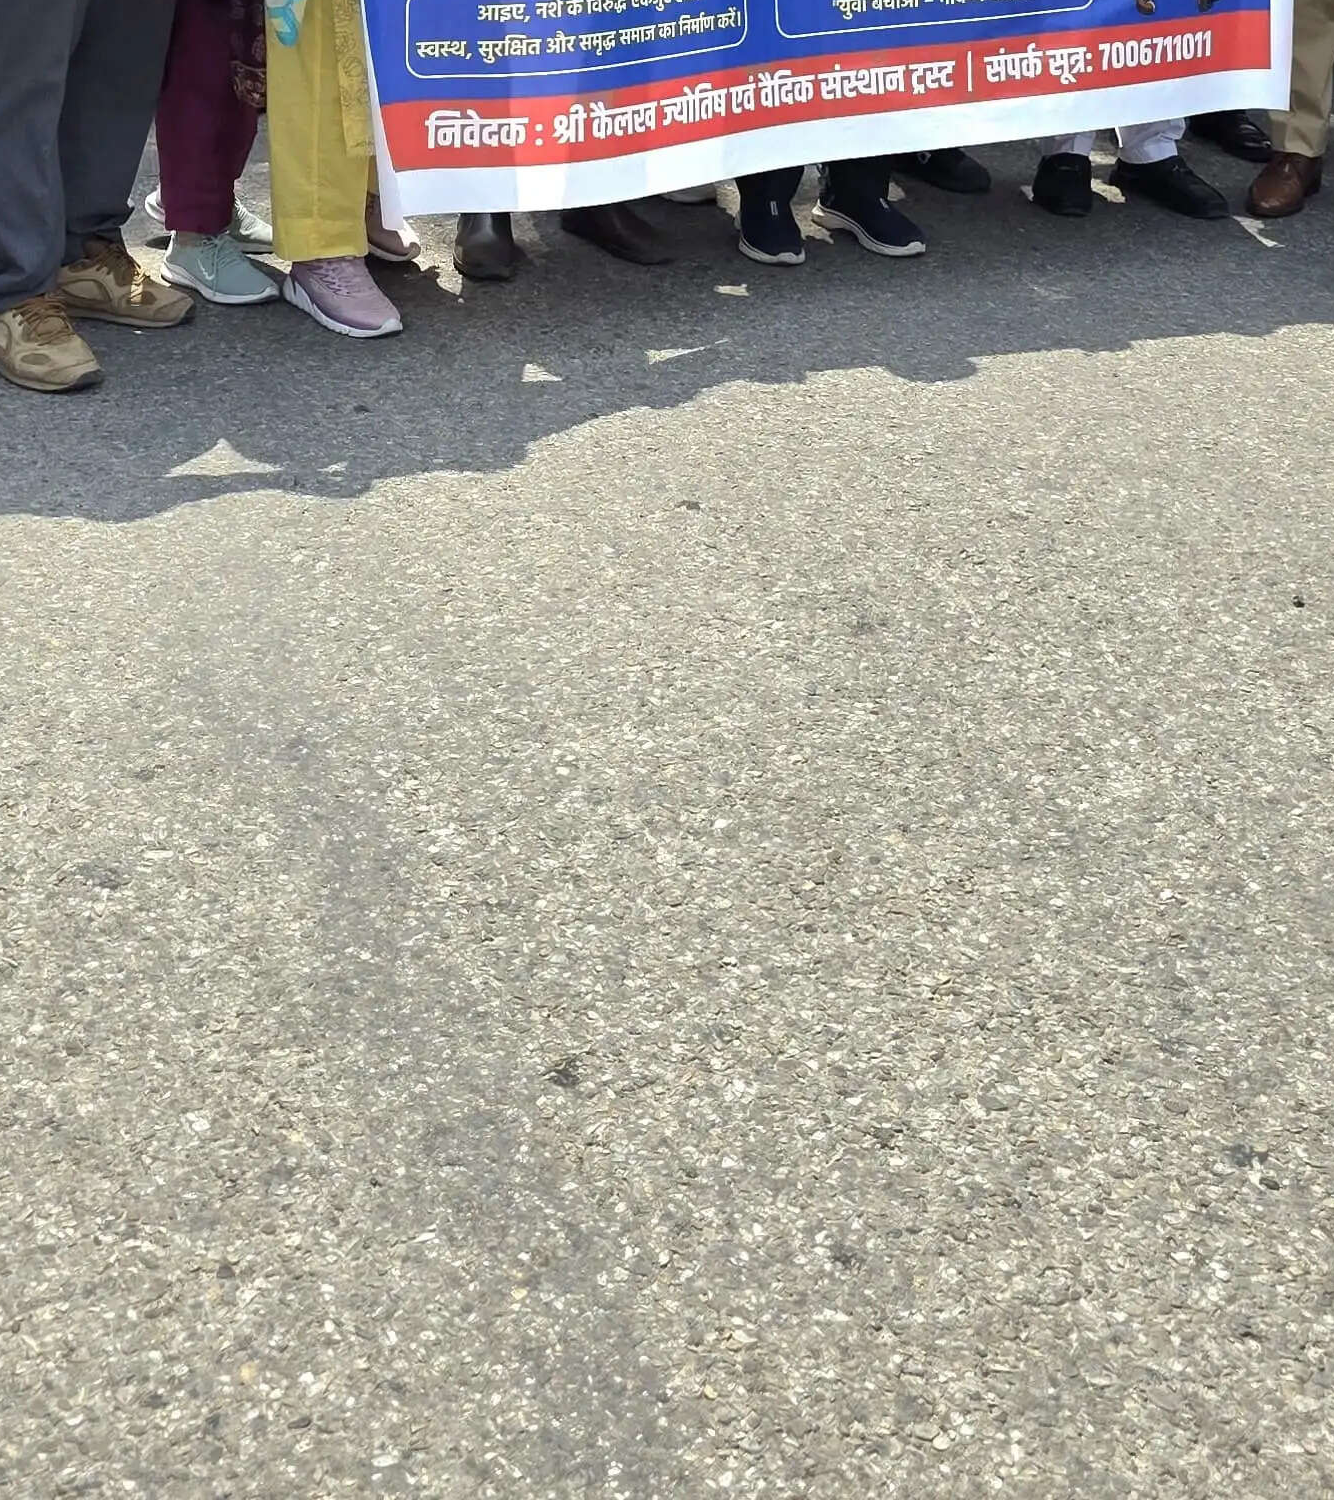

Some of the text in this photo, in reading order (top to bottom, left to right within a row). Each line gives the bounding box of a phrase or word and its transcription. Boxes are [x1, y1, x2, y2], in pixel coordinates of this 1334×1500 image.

[415, 38, 473, 60] स्वस्थ,
[477, 34, 541, 64] सुरक्षित
[545, 30, 576, 54] और
[579, 28, 616, 57] समृद्ध
[619, 26, 656, 46] समाज
[658, 20, 676, 40] का
[678, 13, 715, 38] निर्माण
[477, 3, 531, 23] आइए,
[425, 109, 529, 150] निवेदक
[552, 99, 587, 145] श्री
[590, 101, 657, 141] कैलख
[660, 82, 728, 127] ज्योतिष
[730, 76, 755, 115] एवं
[758, 63, 815, 109] वैदिक
[820, 57, 906, 101] संस्थान
[909, 58, 957, 96] ट्रस्ट
[983, 42, 1044, 84] संपर्क
[1047, 45, 1093, 85] सूत्र:
[1098, 29, 1212, 72] 7006711011
